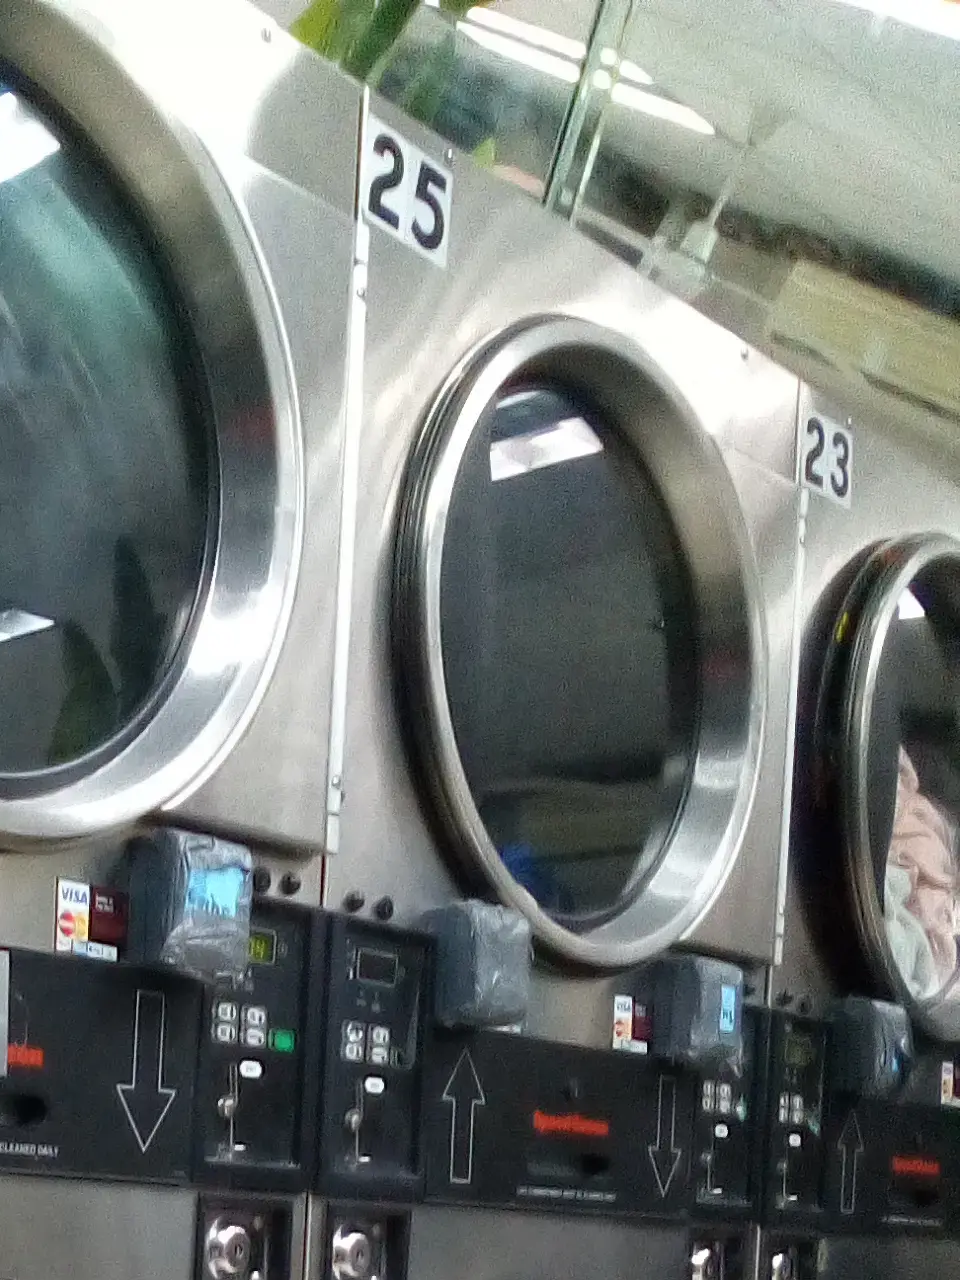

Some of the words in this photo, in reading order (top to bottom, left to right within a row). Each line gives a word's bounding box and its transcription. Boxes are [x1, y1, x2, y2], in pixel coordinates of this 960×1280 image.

[368, 133, 447, 250] 25
[805, 417, 848, 498] 23
[61, 886, 87, 905] VISA
